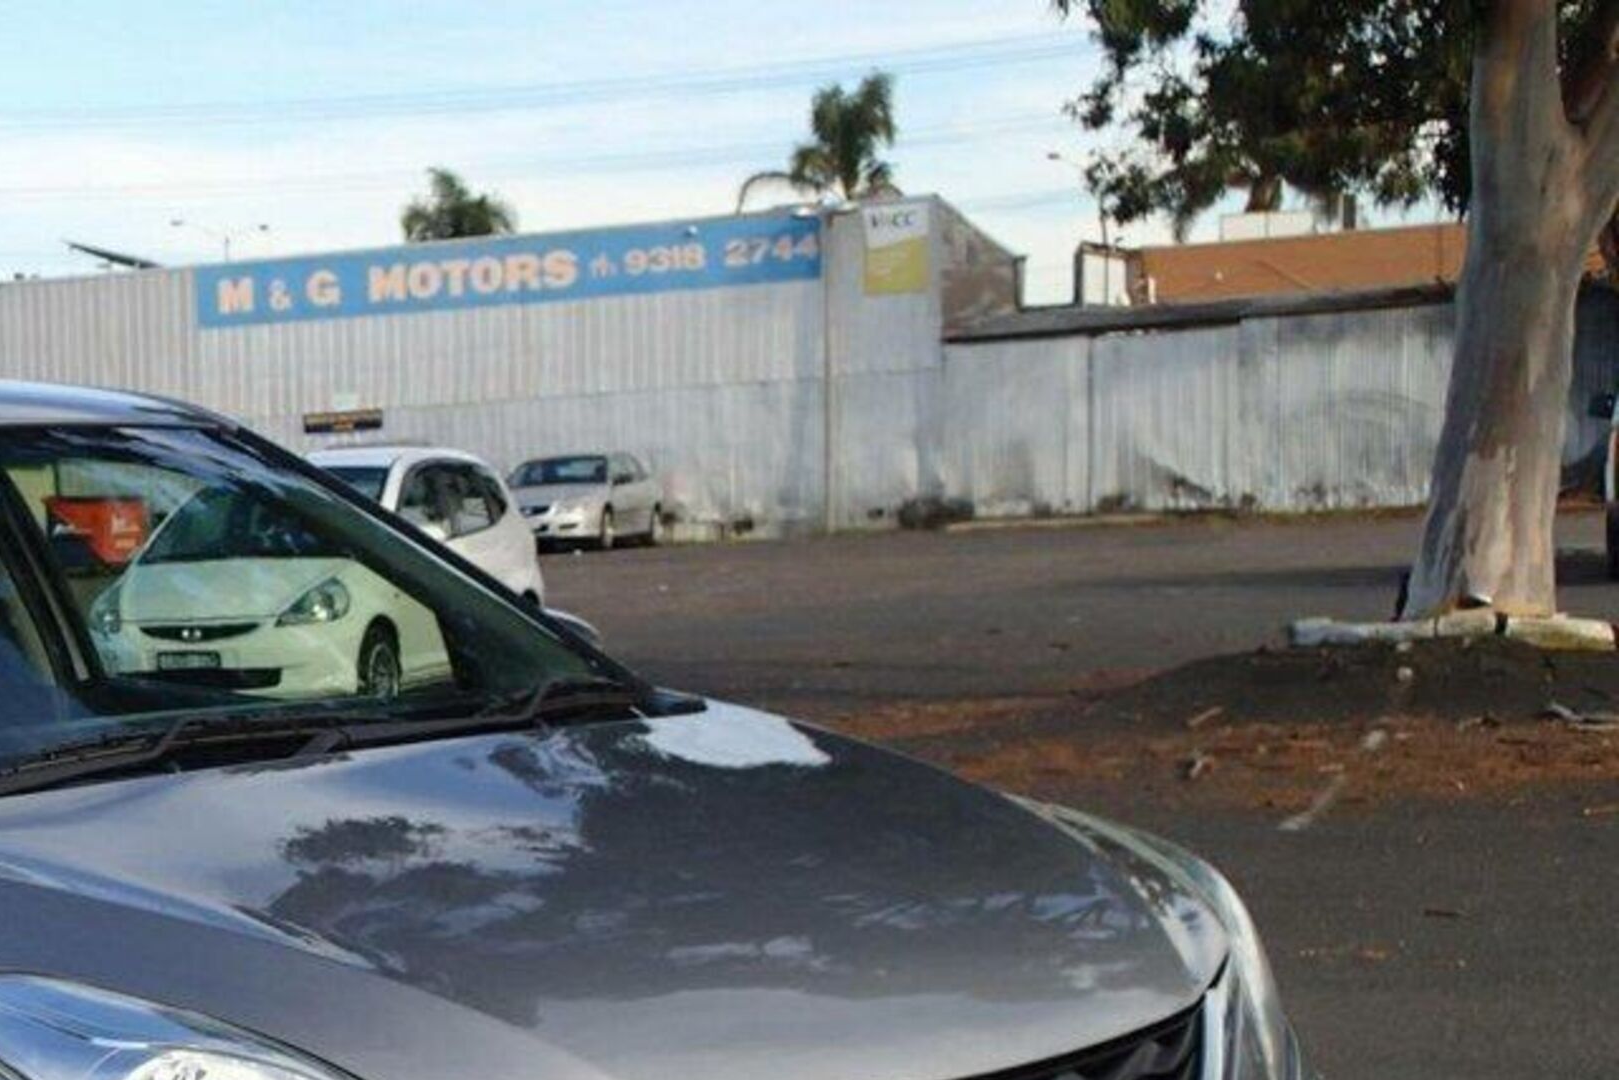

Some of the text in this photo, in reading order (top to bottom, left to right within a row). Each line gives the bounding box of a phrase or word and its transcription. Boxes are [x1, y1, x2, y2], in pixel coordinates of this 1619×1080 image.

[217, 276, 254, 314] M
[268, 278, 292, 311] &
[306, 269, 341, 306] G
[368, 249, 577, 303] MOTORS
[624, 242, 706, 276] 9318
[724, 233, 818, 268] 2744
